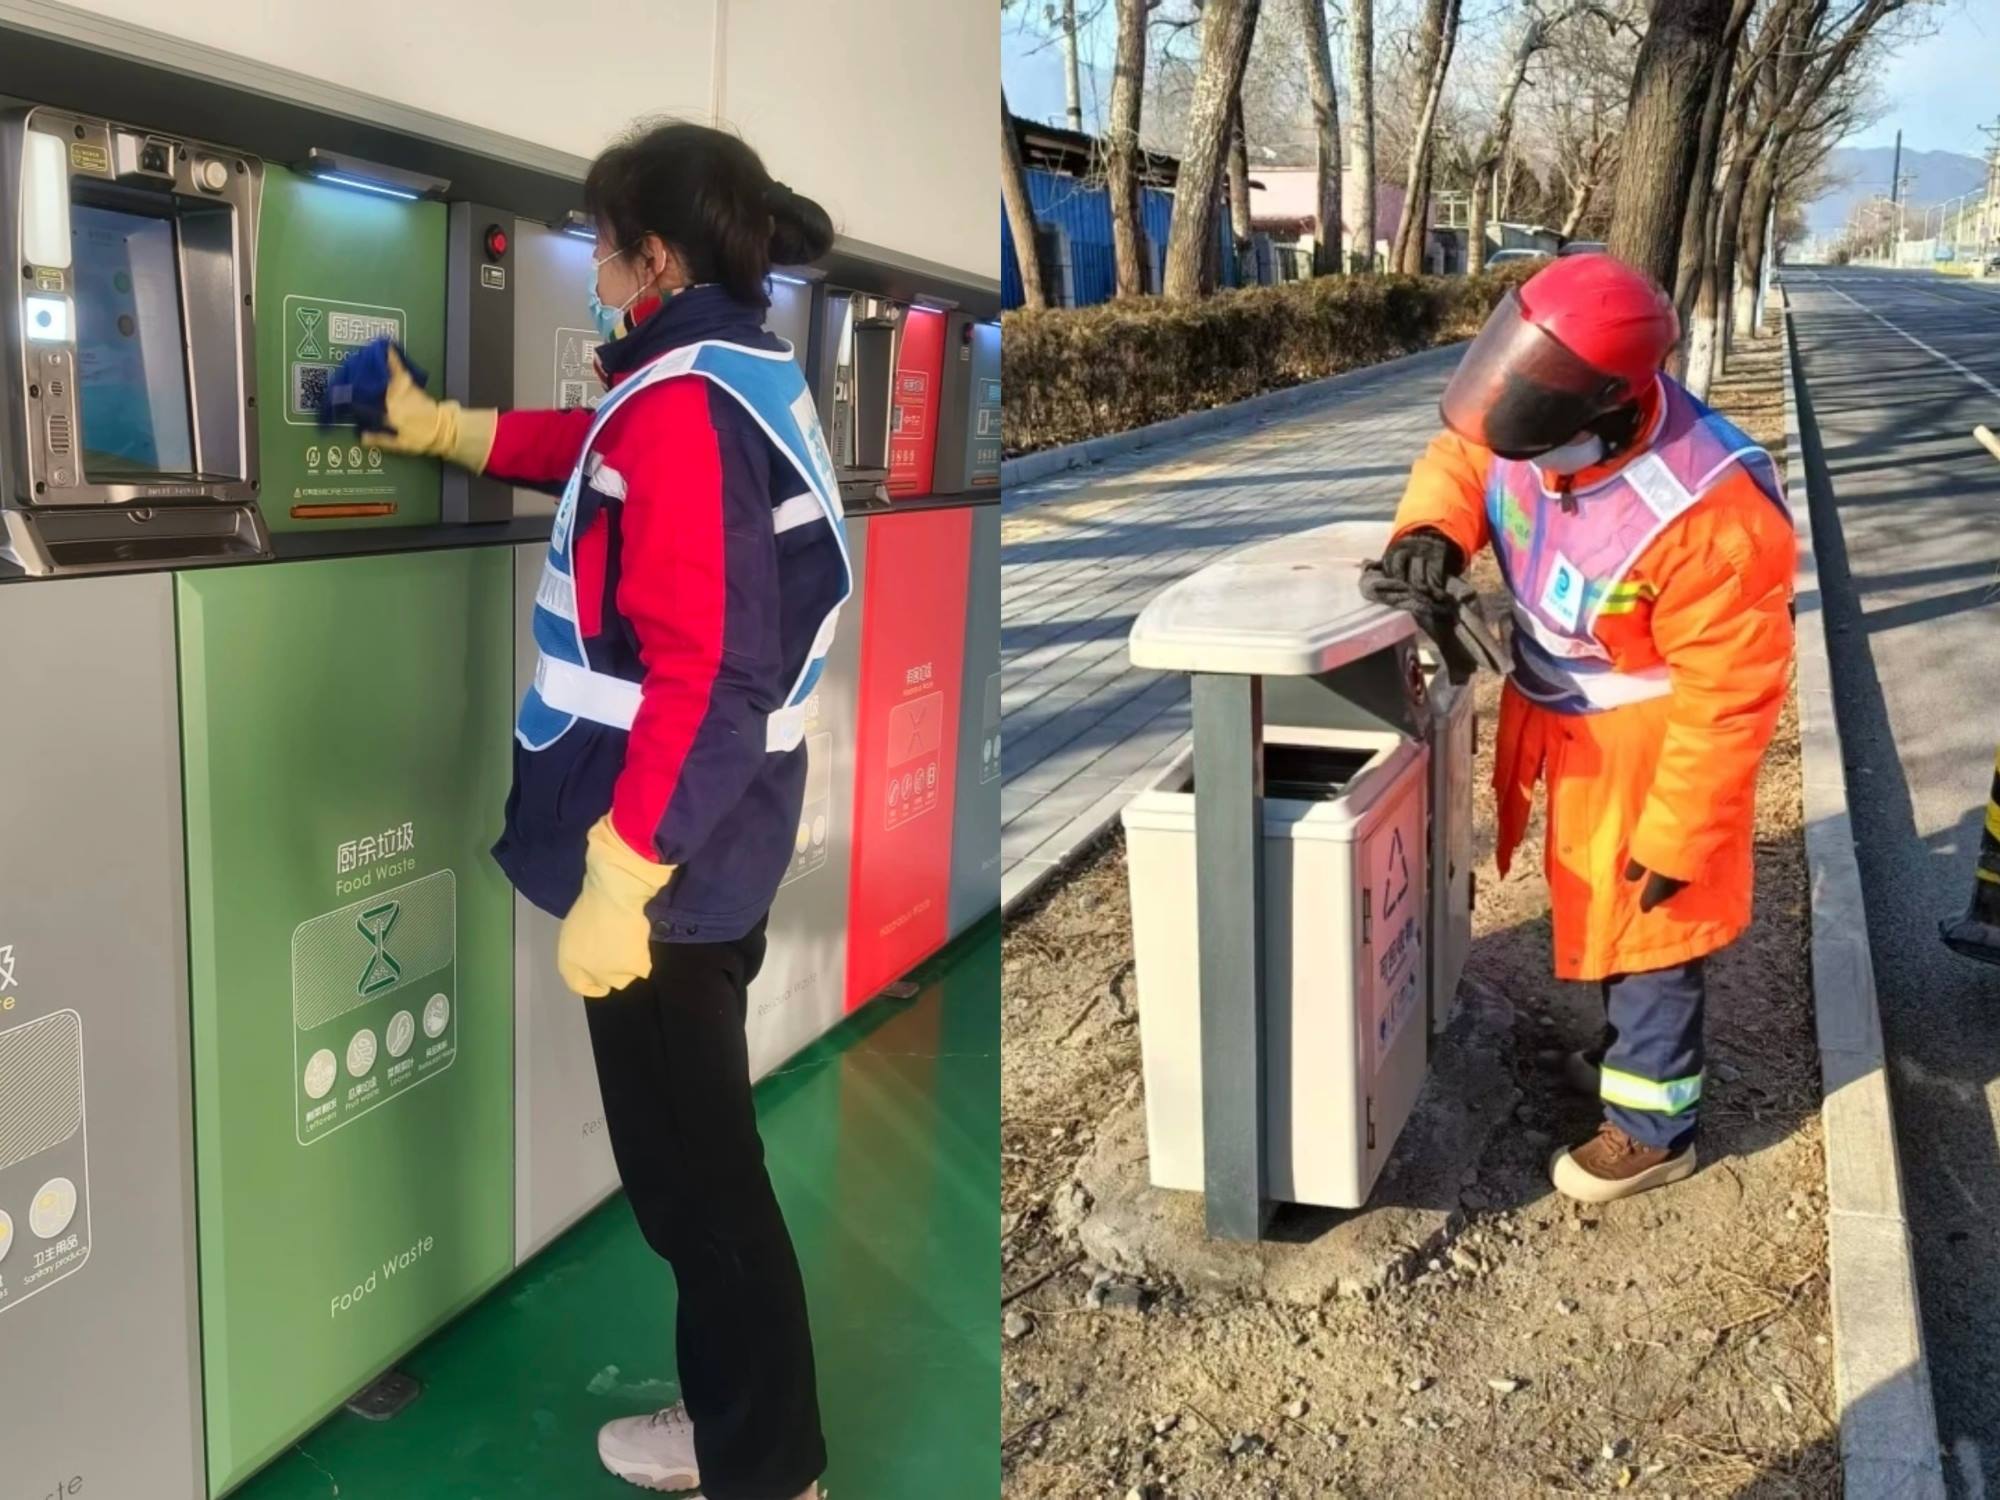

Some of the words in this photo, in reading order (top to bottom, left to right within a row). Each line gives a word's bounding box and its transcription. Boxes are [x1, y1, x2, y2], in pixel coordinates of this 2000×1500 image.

[336, 821, 415, 875] 厨余垃圾
[335, 869, 372, 897] Food
[375, 857, 416, 881] Waste
[33, 1233, 78, 1269] 卫生用品
[330, 1270, 377, 1319] Food
[382, 1235, 434, 1280] Waste
